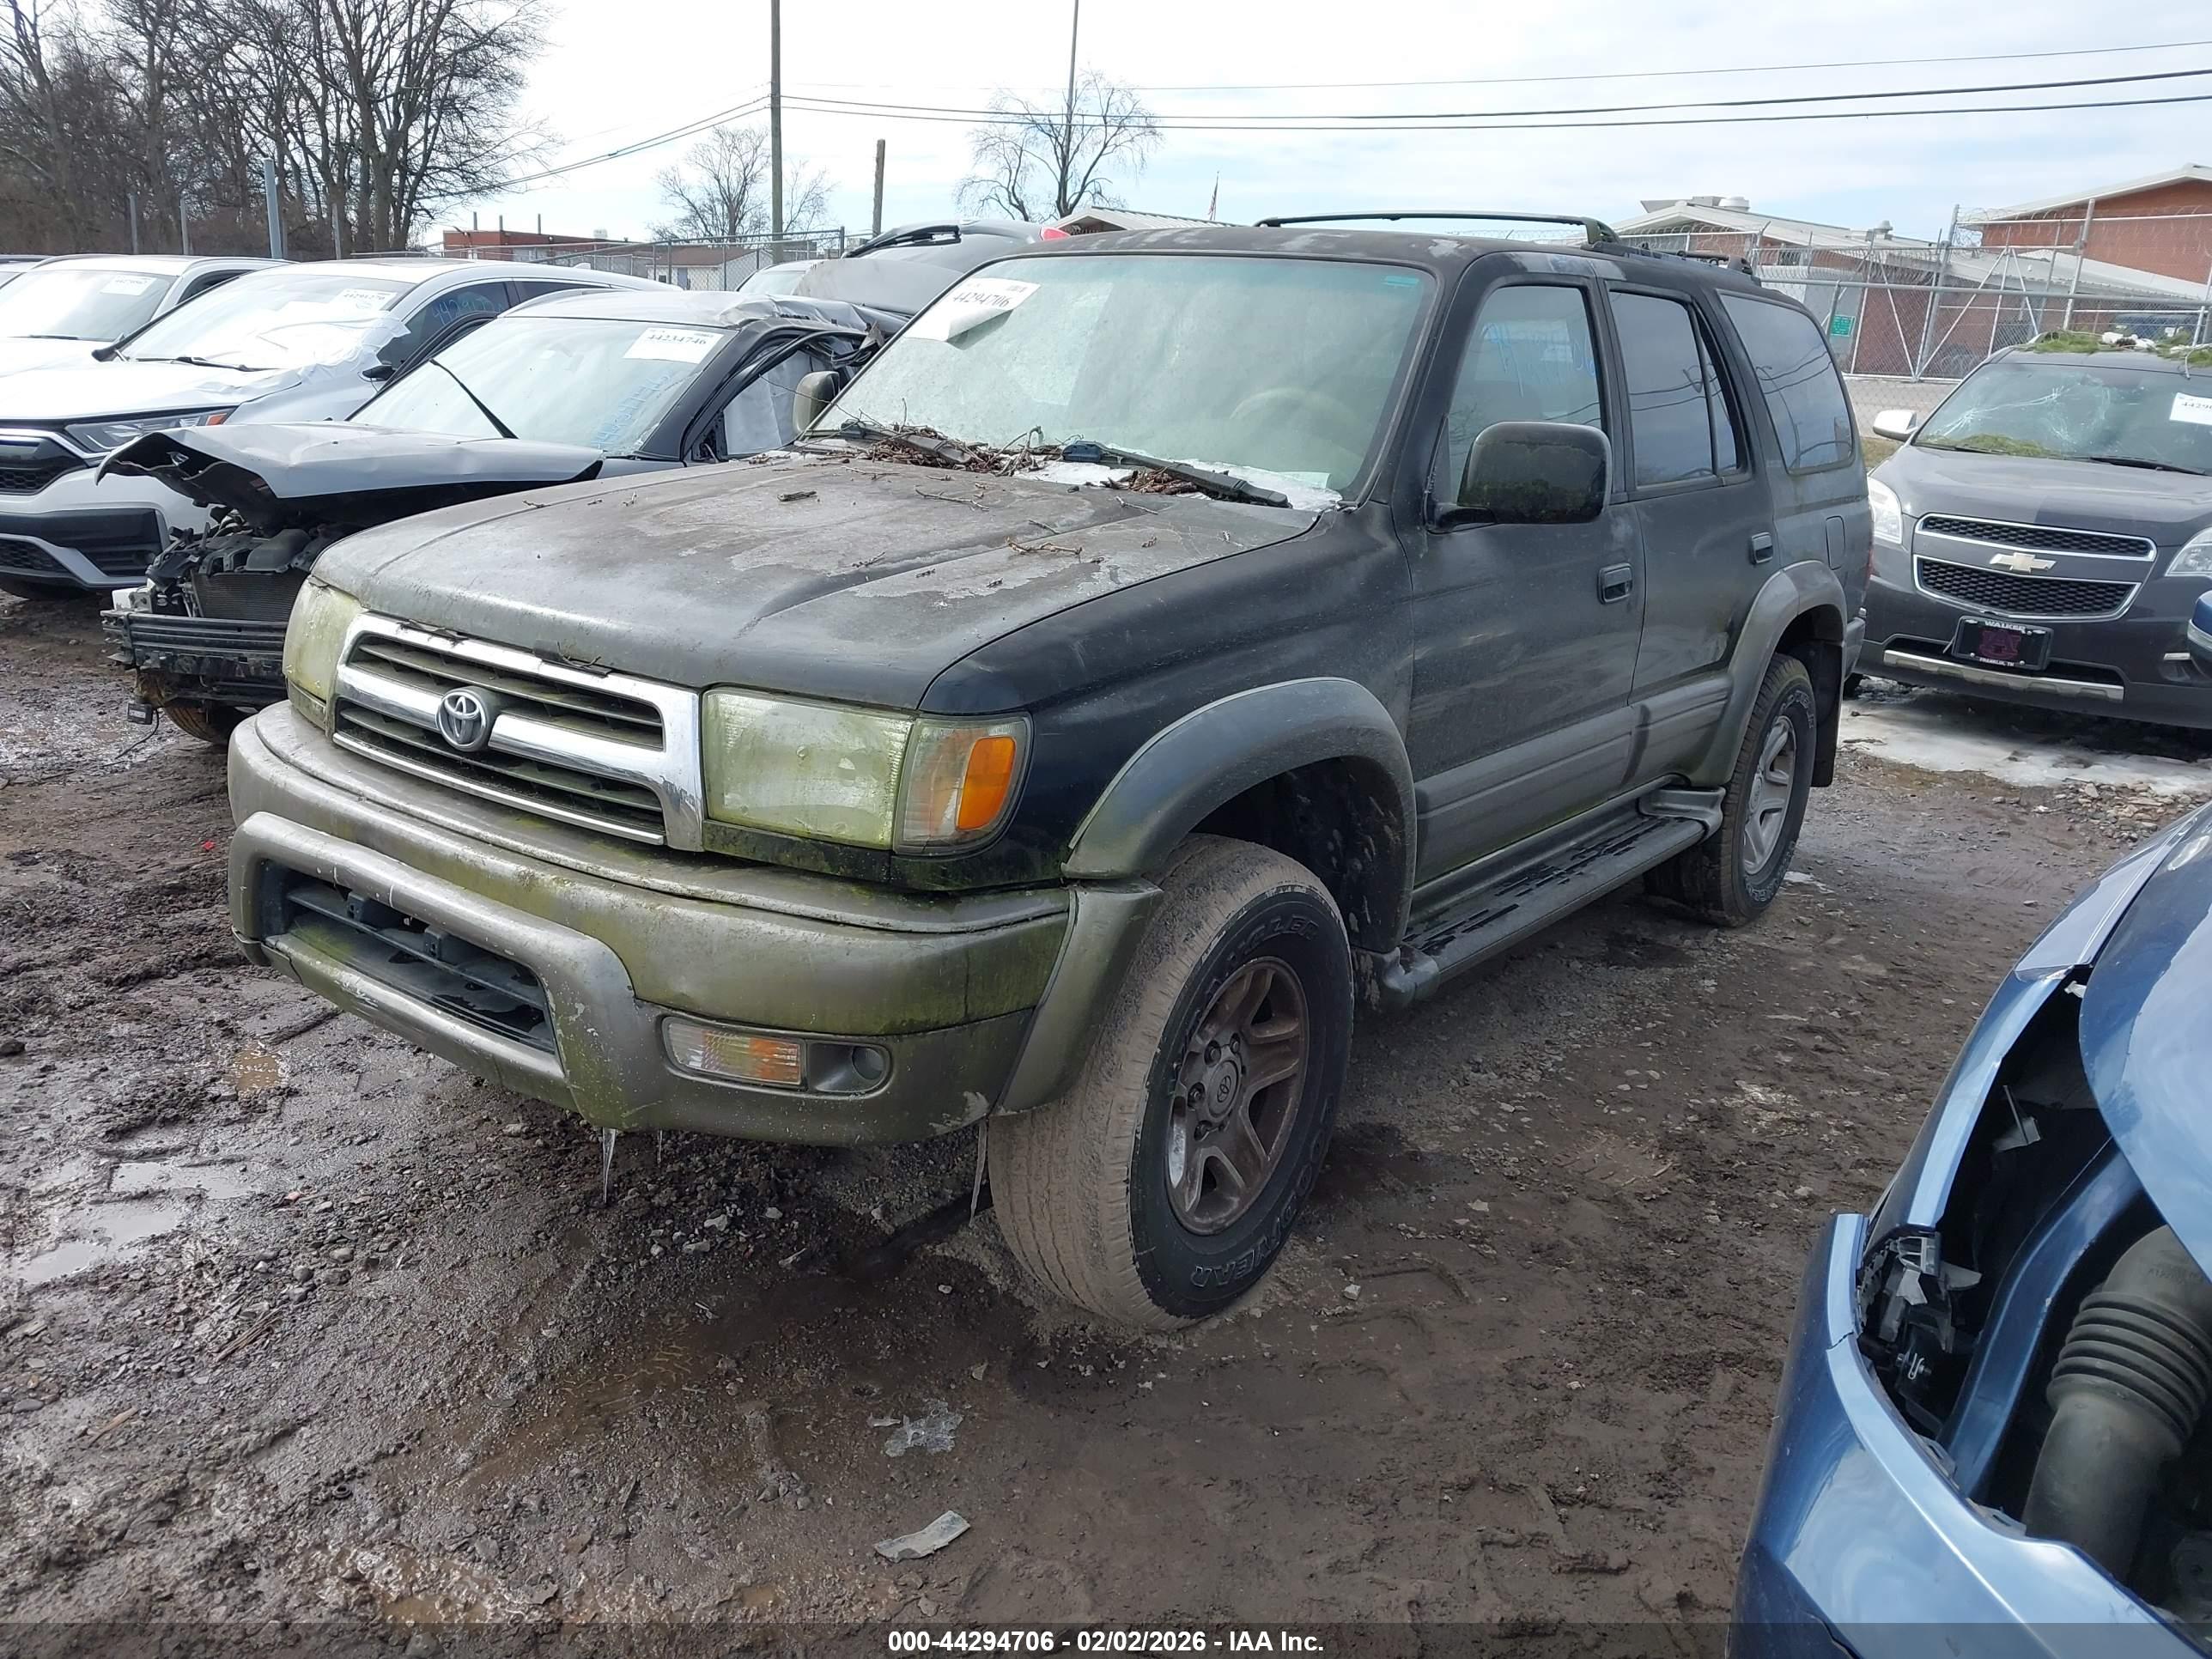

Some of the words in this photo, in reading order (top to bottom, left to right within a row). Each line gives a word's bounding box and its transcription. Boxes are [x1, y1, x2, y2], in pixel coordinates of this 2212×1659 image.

[953, 293, 1012, 307] 44294706
[647, 333, 707, 344] 44234746
[1984, 620, 2027, 635] WALKER
